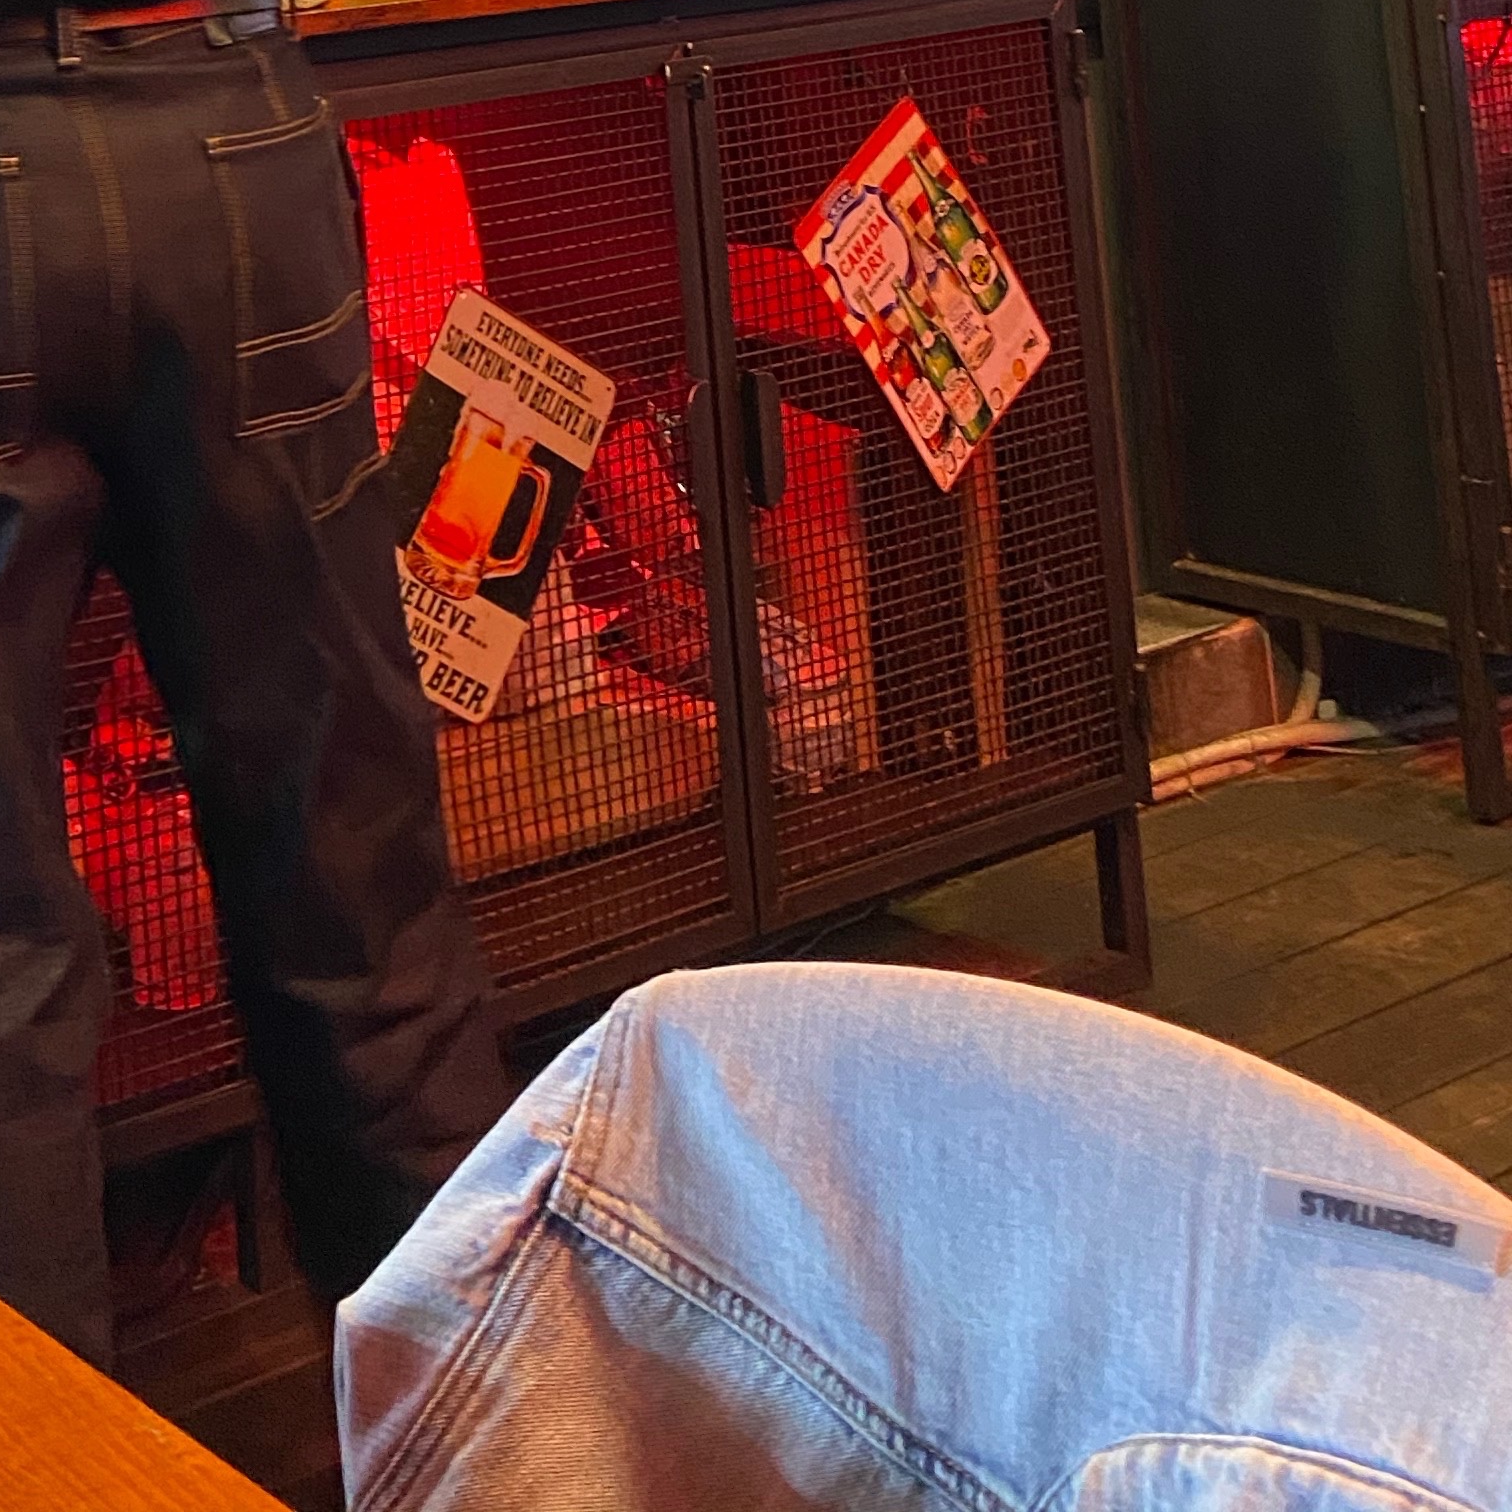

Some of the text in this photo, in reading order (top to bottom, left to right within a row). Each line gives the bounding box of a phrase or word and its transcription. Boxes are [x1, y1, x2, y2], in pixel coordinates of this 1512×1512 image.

[838, 214, 889, 278] CANADA
[858, 244, 886, 285] DRY
[475, 311, 544, 368] EVERYONE
[440, 324, 602, 447] SOMETHING TO BELIEVE IN
[425, 659, 489, 715] BEER
